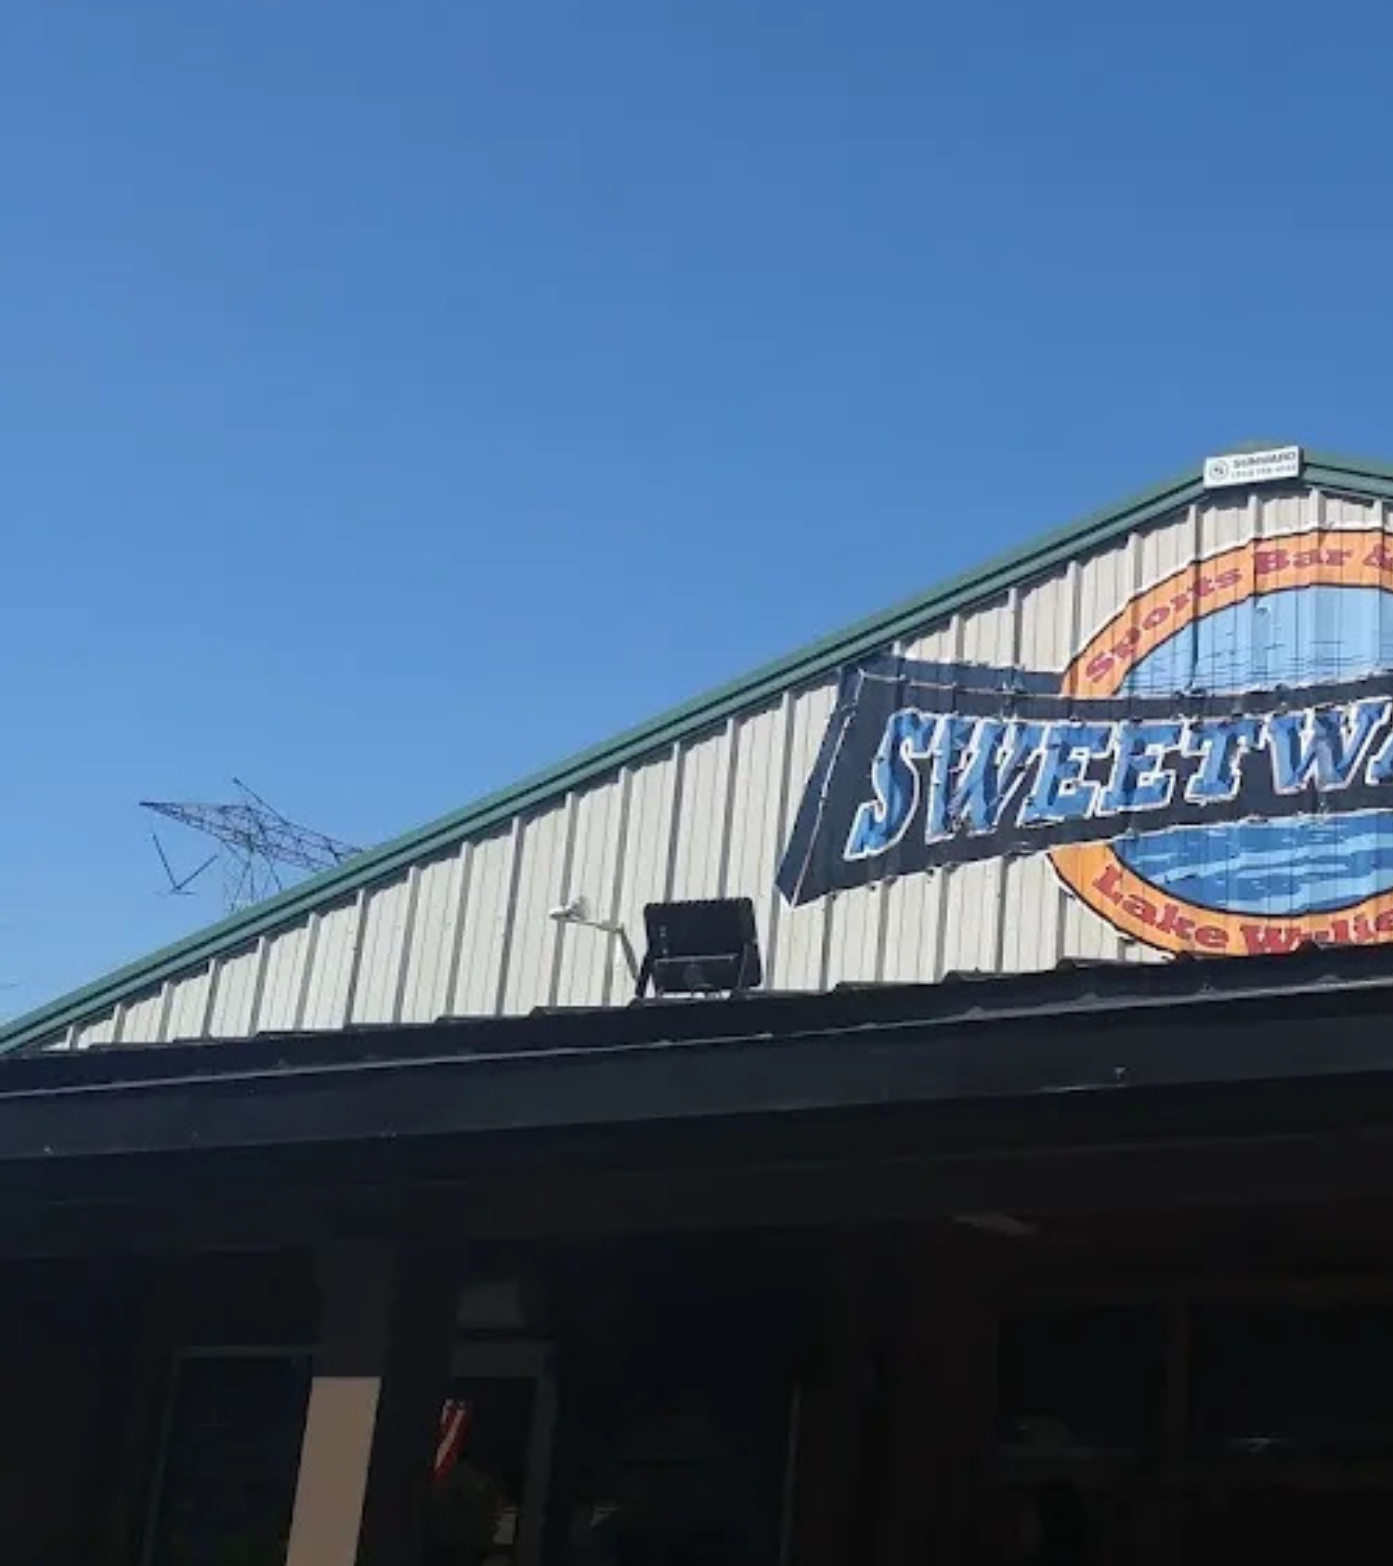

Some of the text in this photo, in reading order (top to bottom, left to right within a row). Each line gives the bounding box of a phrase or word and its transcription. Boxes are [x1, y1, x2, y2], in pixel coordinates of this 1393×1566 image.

[1085, 564, 1243, 683] Sports
[1253, 545, 1353, 574] Bar
[1093, 864, 1229, 950] Lake
